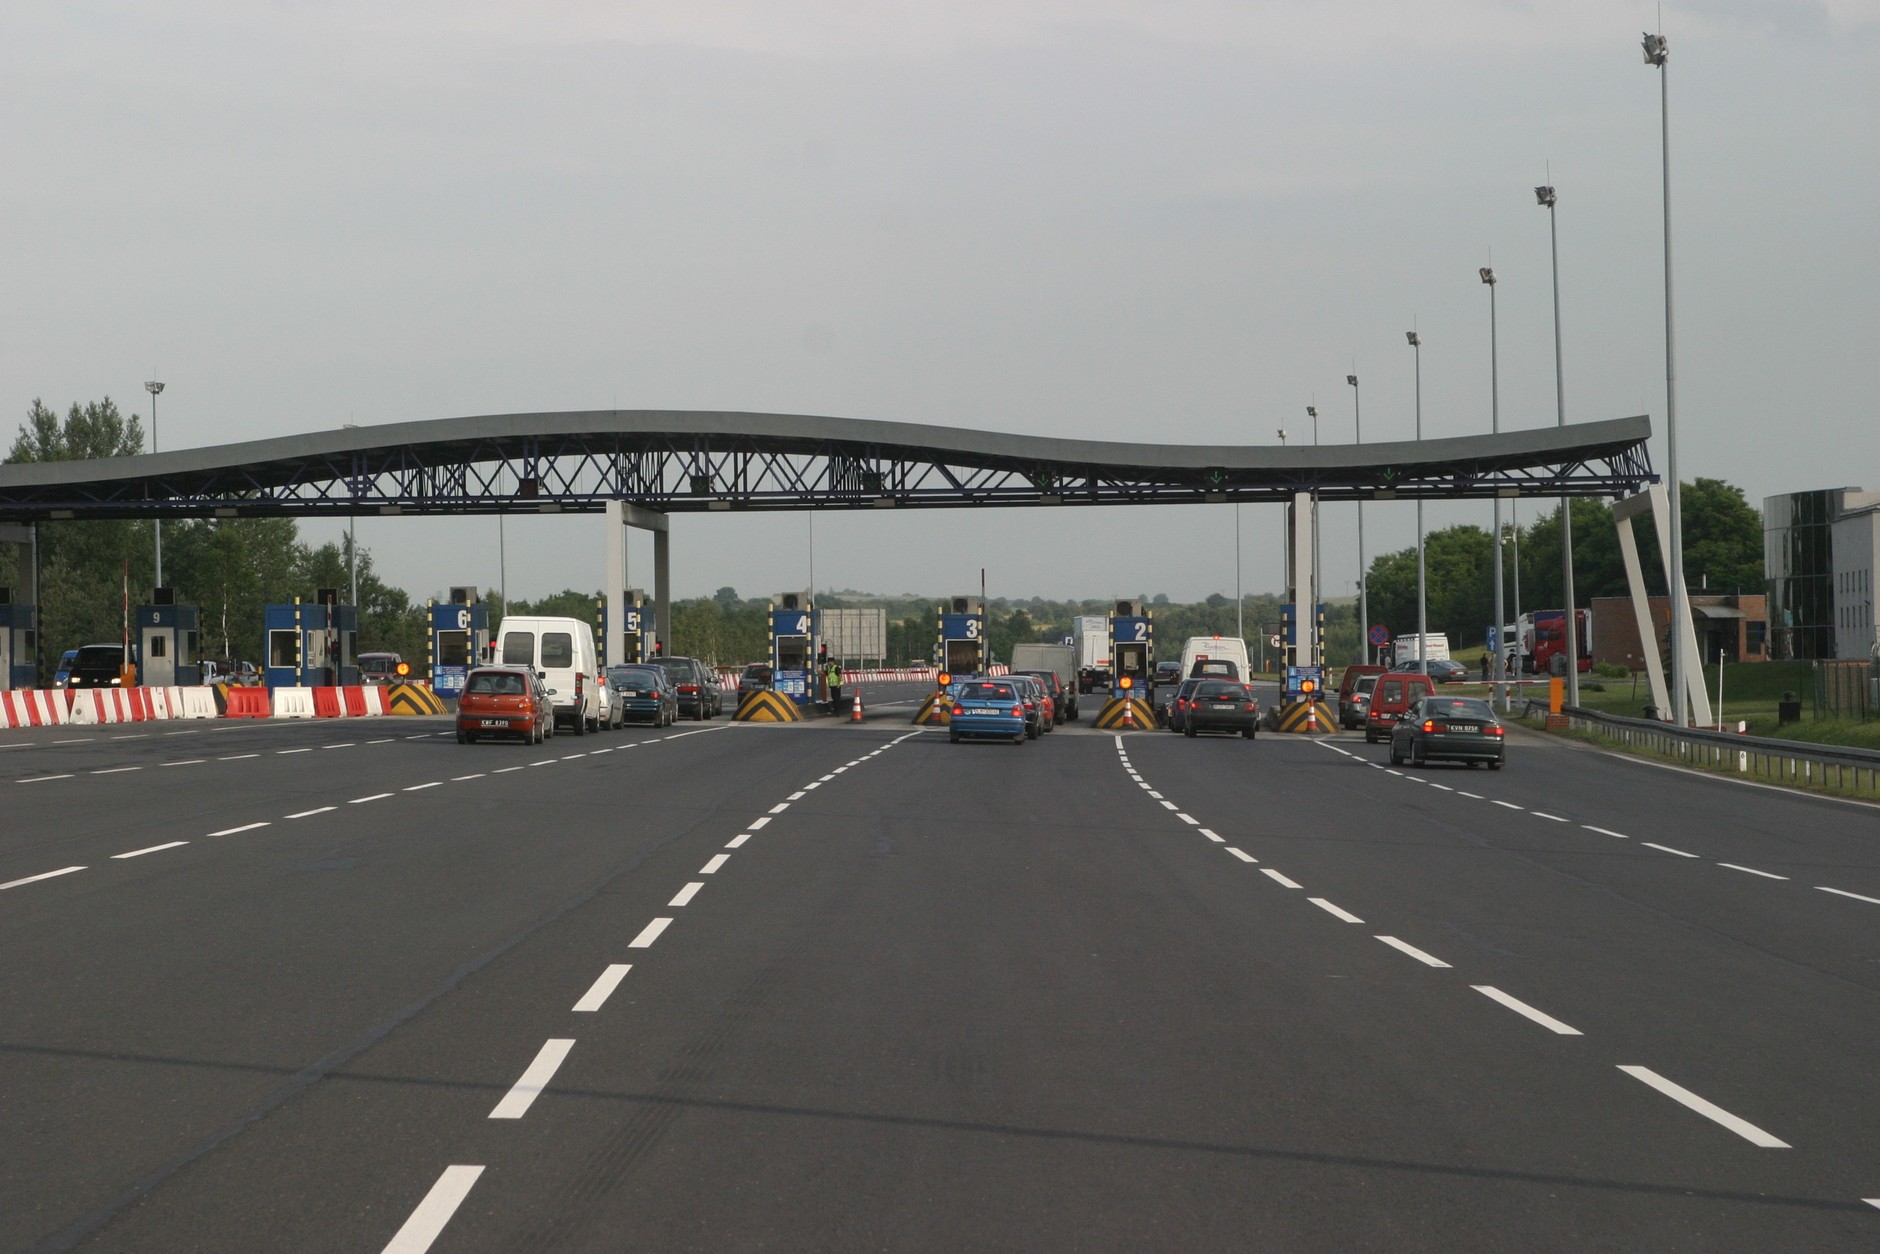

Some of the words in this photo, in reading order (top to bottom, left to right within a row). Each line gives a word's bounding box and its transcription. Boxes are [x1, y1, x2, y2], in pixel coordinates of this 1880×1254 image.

[153, 612, 160, 624] 9
[458, 610, 467, 629] 6
[628, 612, 637, 630] 5
[796, 615, 807, 633] 4
[966, 619, 978, 638] 3
[1135, 622, 1147, 641] 2
[1489, 627, 1496, 637] P
